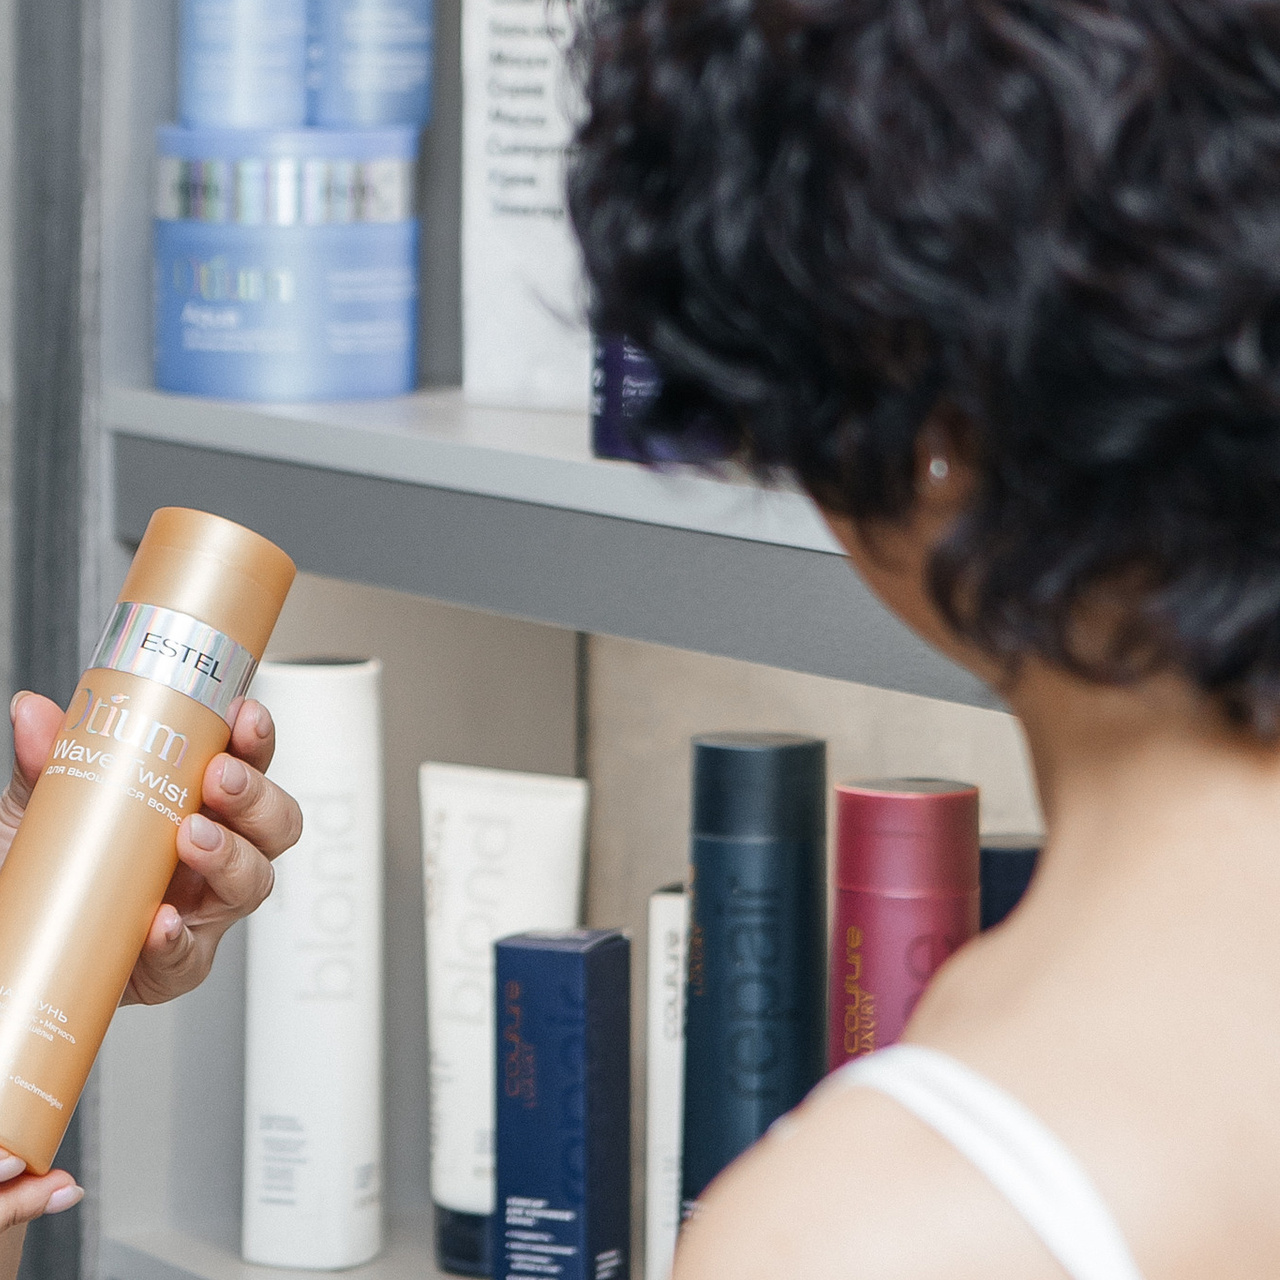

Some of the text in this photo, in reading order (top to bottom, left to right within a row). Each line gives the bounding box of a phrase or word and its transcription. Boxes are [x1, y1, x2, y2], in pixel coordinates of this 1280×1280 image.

[140, 632, 222, 684] ESTEL
[64, 687, 189, 769] Otium
[53, 739, 189, 808] Wave Twist
